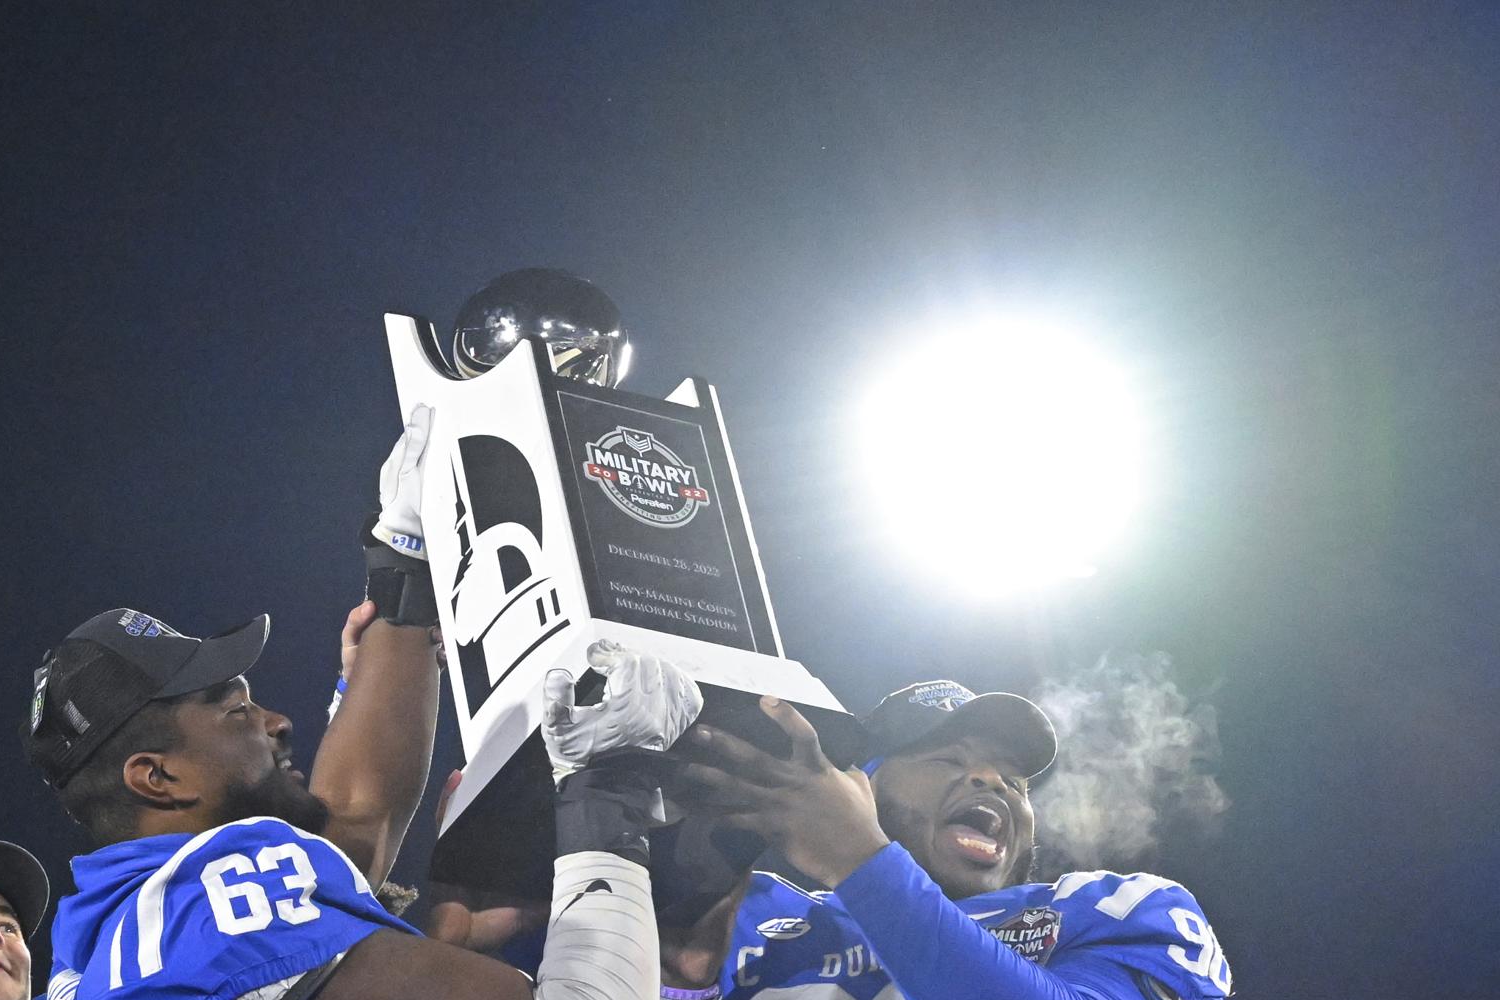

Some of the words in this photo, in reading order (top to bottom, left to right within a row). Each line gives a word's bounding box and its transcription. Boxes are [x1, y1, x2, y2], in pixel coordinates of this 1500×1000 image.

[593, 466, 611, 478] 20
[594, 448, 690, 485] MILITARY
[618, 470, 678, 498] BOWL
[683, 489, 701, 498] 22
[630, 493, 674, 511] Peraton
[608, 543, 671, 567] DECEMBER
[694, 563, 720, 577] 2022
[616, 598, 682, 620] MEMORIAL
[684, 612, 737, 632] STADIUM
[697, 599, 736, 617] CORPS
[200, 842, 321, 936] 63
[763, 920, 805, 932] ACC
[990, 924, 1052, 942] MILITAR
[737, 946, 764, 987] C
[818, 944, 885, 977] DU
[1167, 907, 1232, 997] 90
